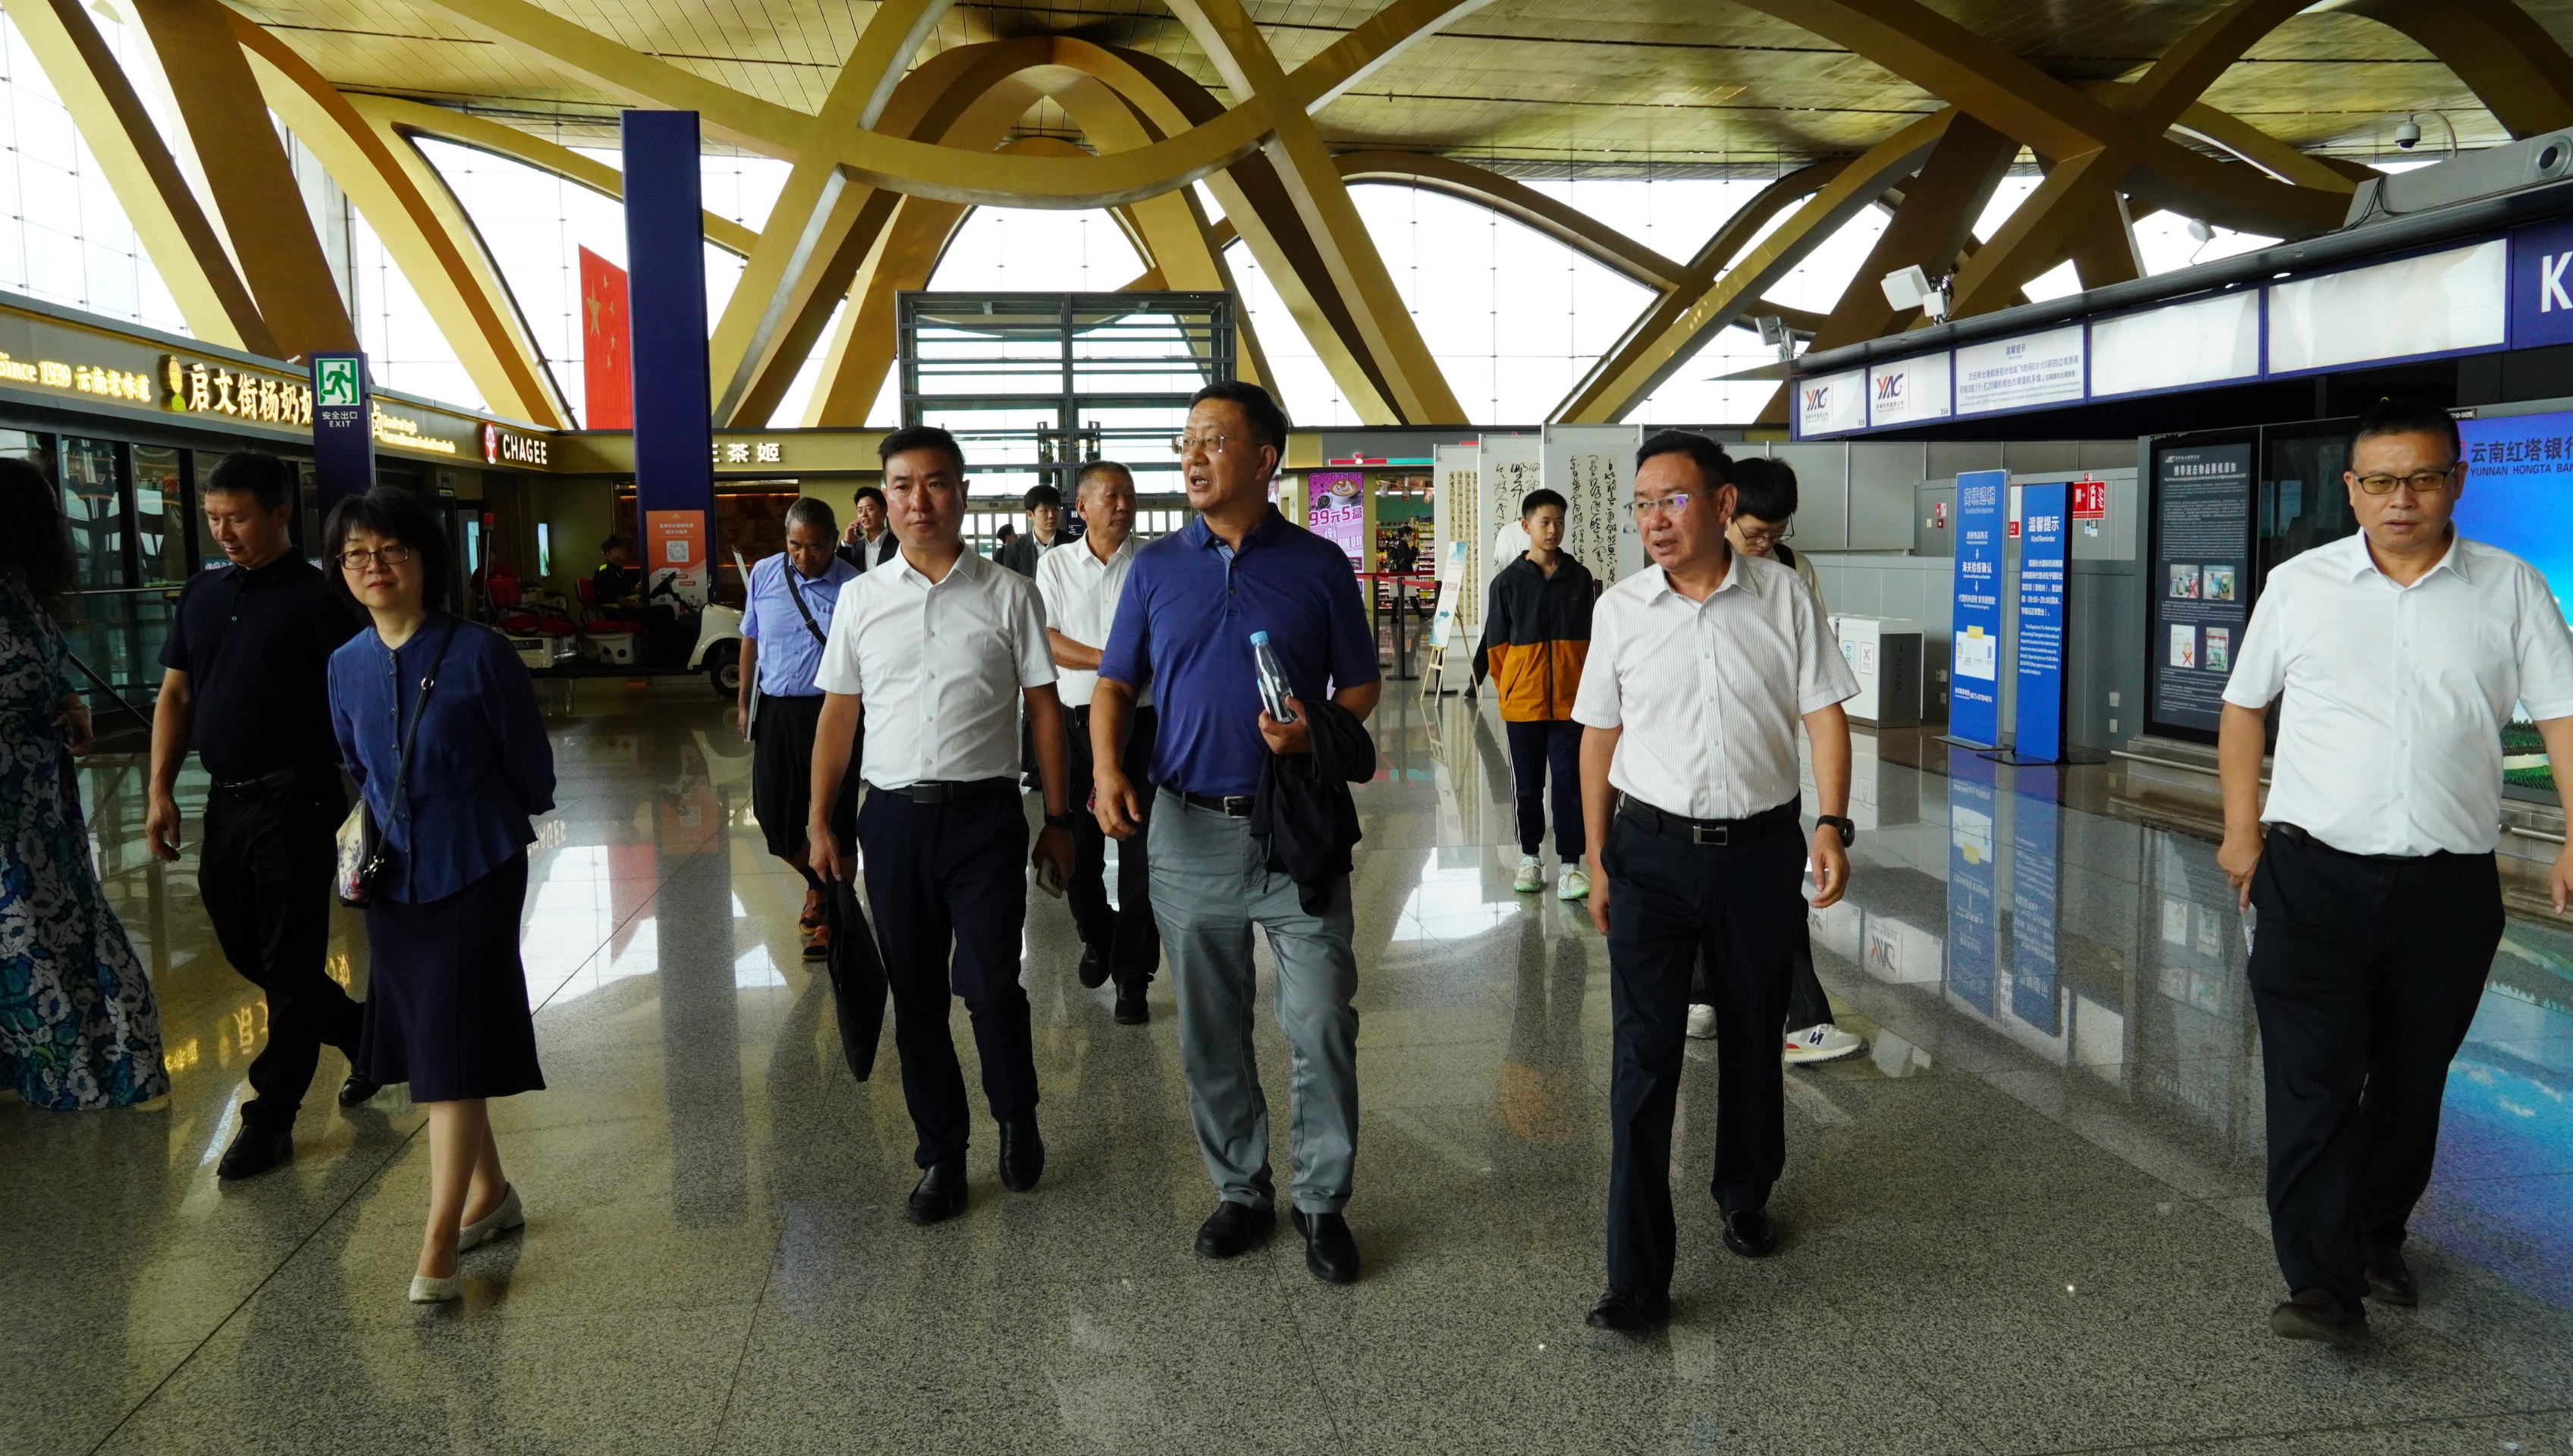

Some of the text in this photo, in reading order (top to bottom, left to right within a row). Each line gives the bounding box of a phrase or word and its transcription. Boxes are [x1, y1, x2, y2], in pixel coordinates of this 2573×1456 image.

[2541, 251, 2573, 312] K
[38, 361, 72, 388] 1939
[322, 411, 358, 421] 安全出口
[502, 434, 548, 465] CHAGEE
[2471, 465, 2508, 477] YUNNAN
[2513, 463, 2551, 475] HONGTA
[2028, 516, 2059, 532] 温馨提示
[1962, 561, 1992, 573] 海关验核确认
